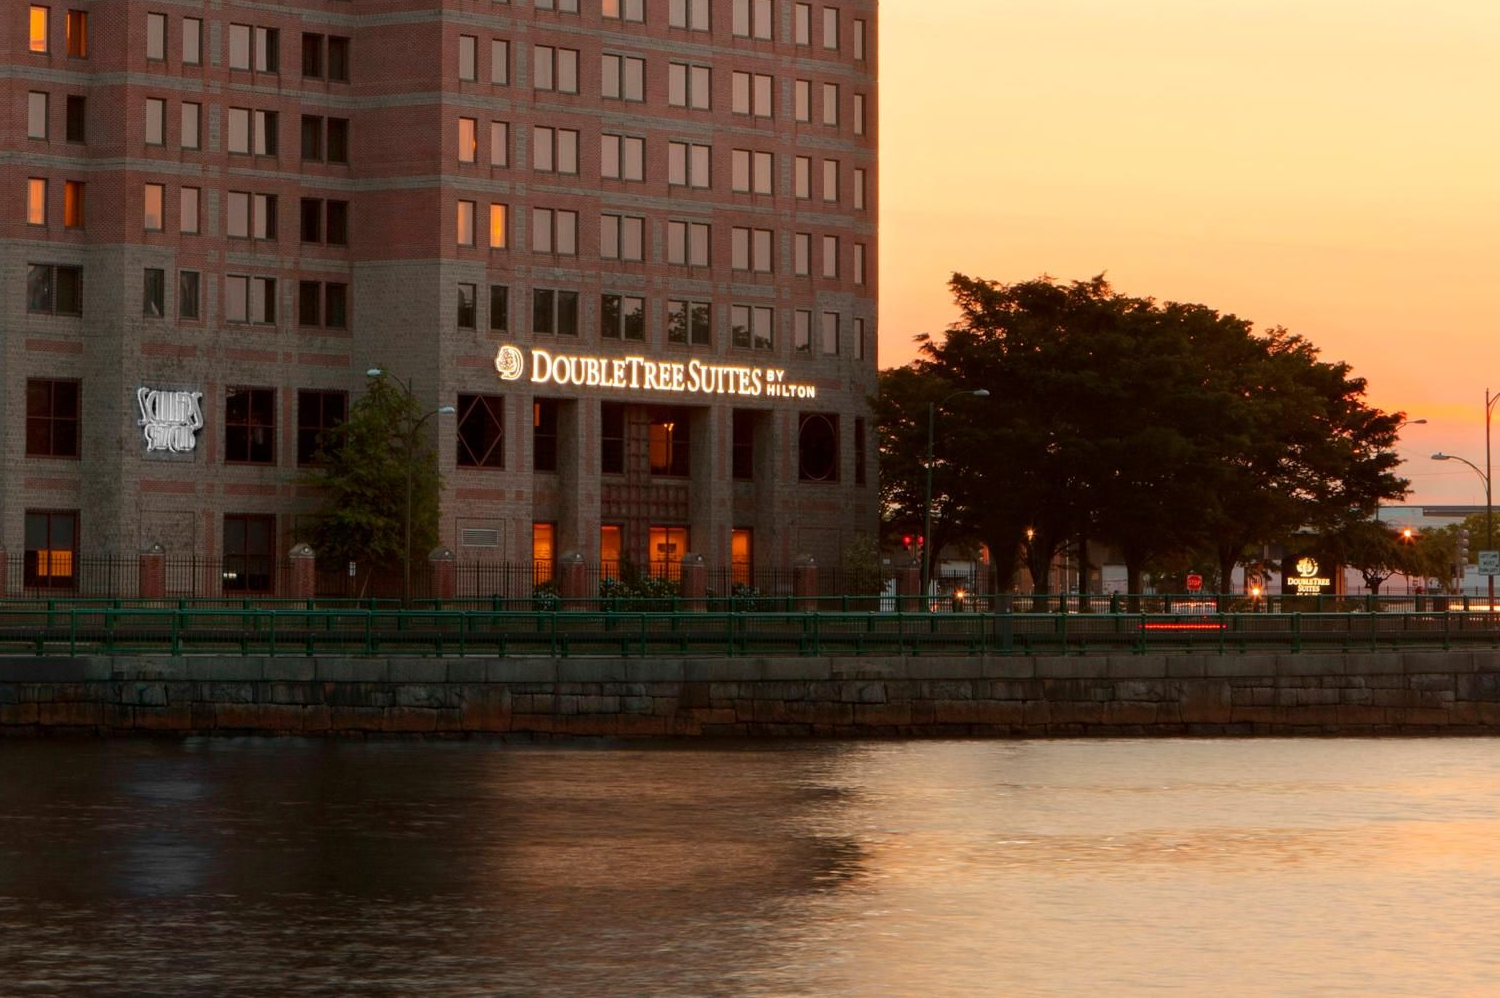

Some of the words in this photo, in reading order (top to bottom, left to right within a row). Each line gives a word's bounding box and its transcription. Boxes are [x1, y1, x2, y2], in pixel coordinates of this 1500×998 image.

[531, 350, 685, 391] DOUBLETREE
[687, 360, 762, 395] SUITES
[766, 369, 785, 382] BY
[766, 384, 816, 398] HILTON
[1187, 578, 1202, 587] STOP
[1297, 584, 1321, 593] SUITES
